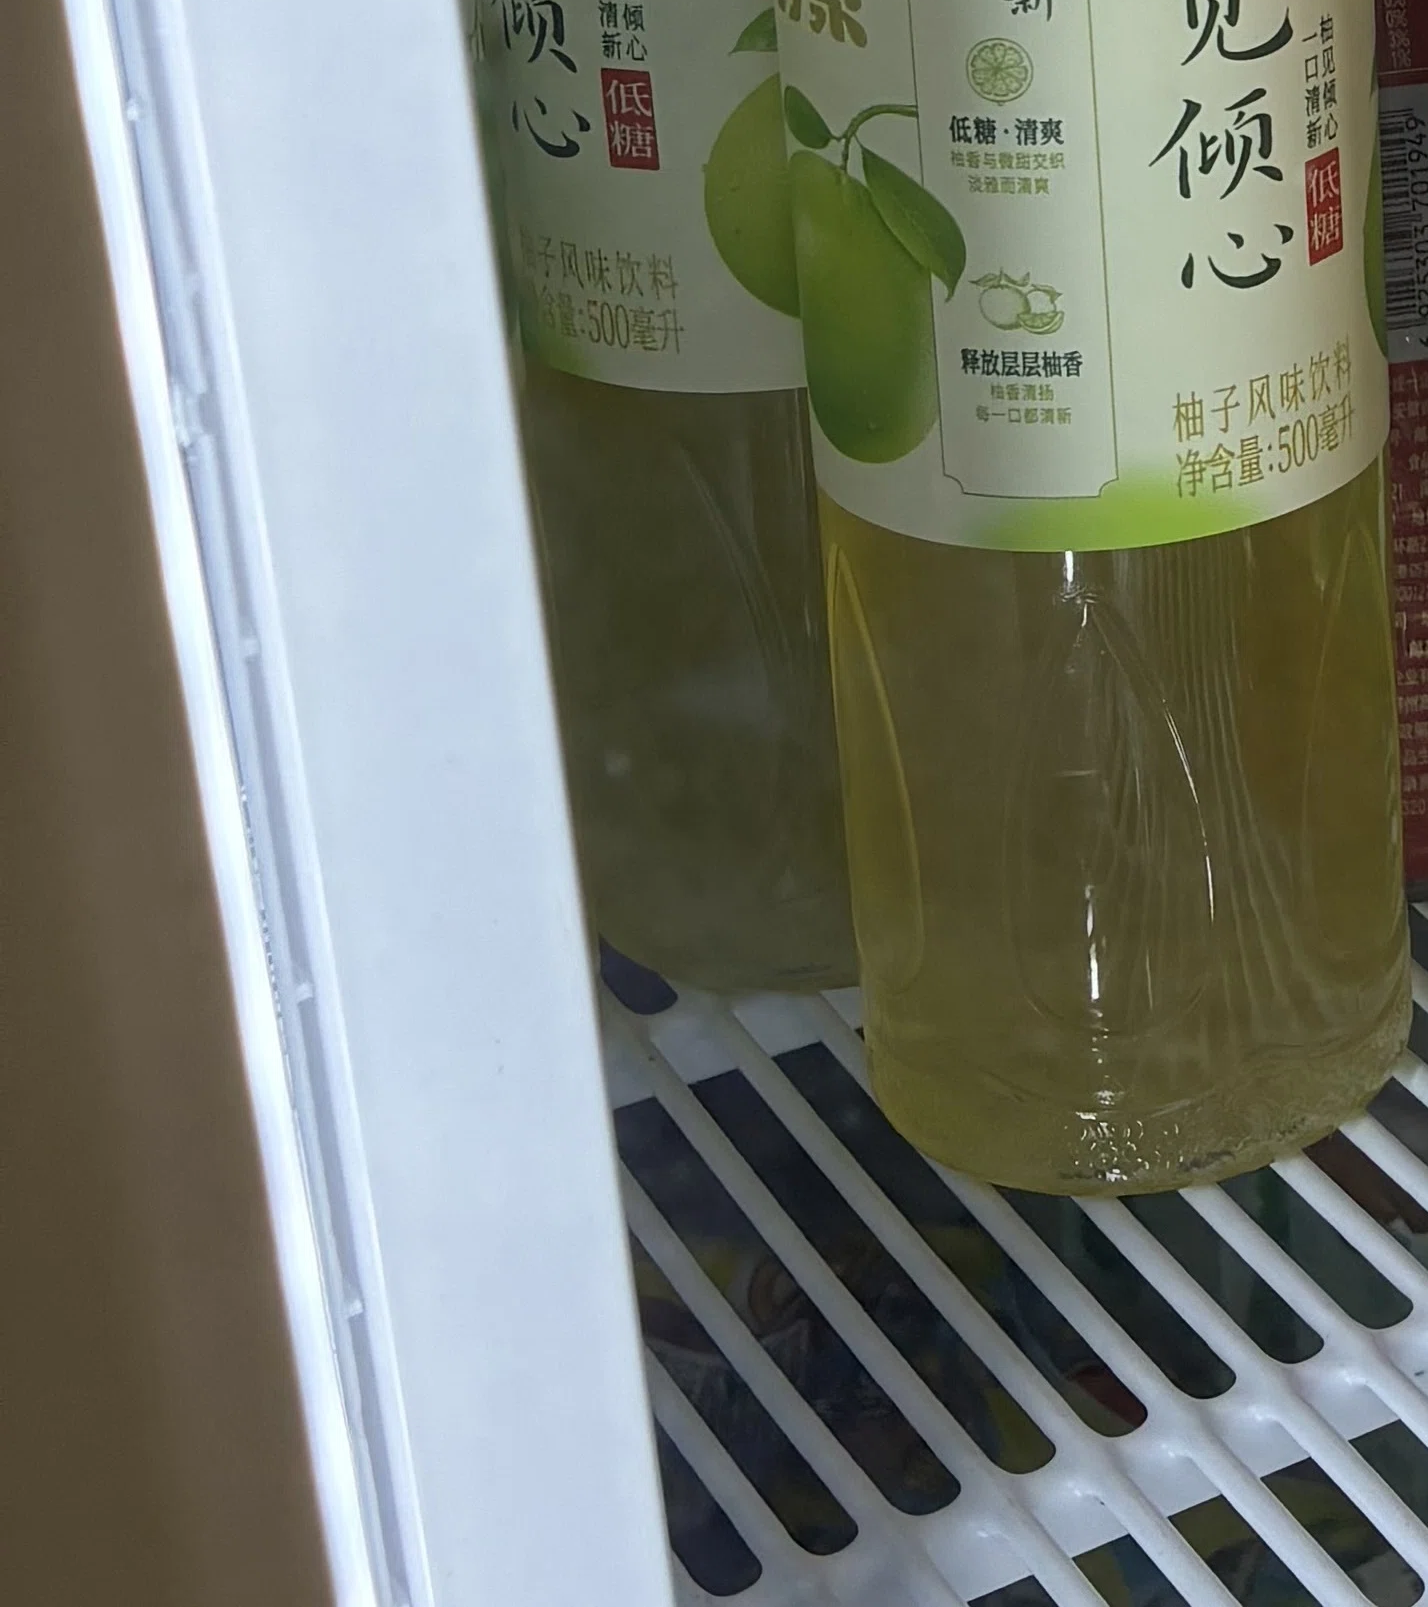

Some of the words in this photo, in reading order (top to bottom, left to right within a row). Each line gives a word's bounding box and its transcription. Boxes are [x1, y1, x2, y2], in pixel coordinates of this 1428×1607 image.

[606, 78, 655, 160] 低糖
[1307, 158, 1342, 253] 低糖
[960, 347, 1084, 378] 释放层层柚香
[1172, 333, 1352, 443] 柚子风味饮料
